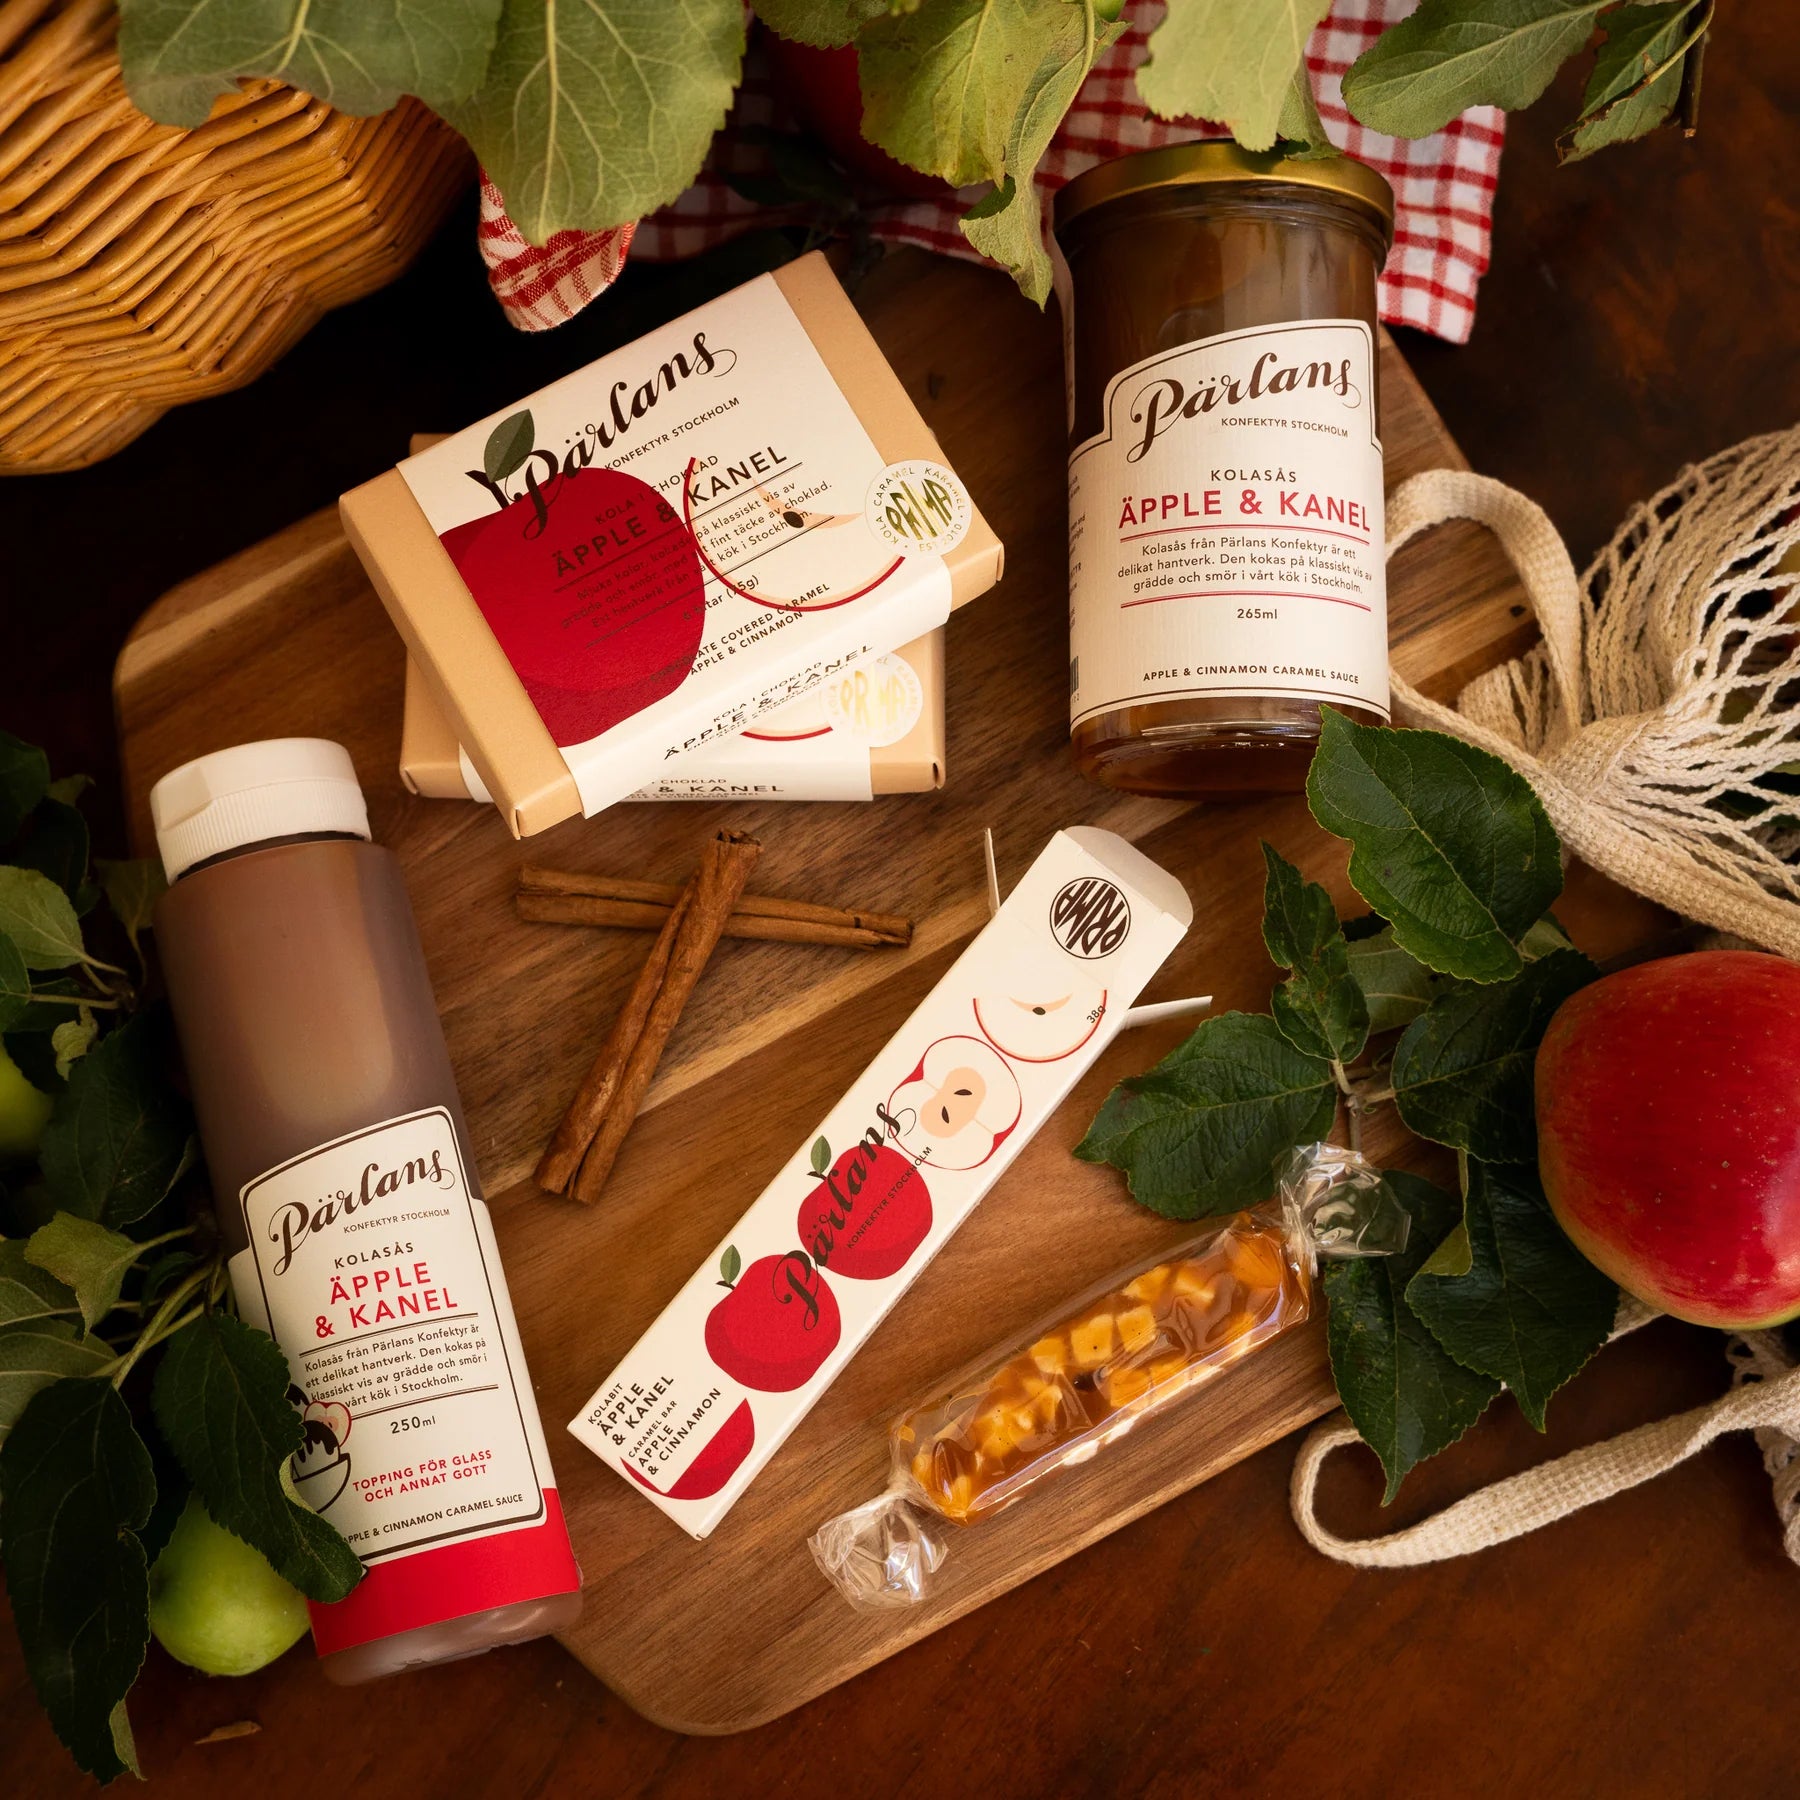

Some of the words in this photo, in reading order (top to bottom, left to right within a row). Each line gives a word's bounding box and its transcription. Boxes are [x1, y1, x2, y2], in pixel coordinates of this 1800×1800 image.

[1126, 352, 1362, 464] Pärlans
[1221, 417, 1288, 428] KONFEKTYR
[1291, 420, 1349, 438] STOCKHOLM
[505, 332, 737, 541] Pärlans
[604, 433, 670, 471] KONFEKTYR
[671, 397, 740, 438] STOCKHOLM
[595, 498, 636, 526] KOLA
[649, 455, 719, 495] CHOKLAD
[873, 467, 915, 507] CARAMEL
[1211, 467, 1297, 483] KOLASÅS
[551, 515, 647, 578] ÄPPLE
[655, 502, 676, 524] &
[686, 446, 787, 507] KANEL
[691, 545, 709, 560] et
[710, 532, 732, 549] fint
[734, 515, 765, 536] täcke
[768, 507, 781, 519] av
[784, 480, 833, 510] choklad.
[695, 526, 710, 542] på
[711, 500, 762, 530] klassiskt
[763, 488, 780, 503] vis
[783, 481, 795, 494] av
[875, 515, 900, 545] KOLA
[885, 478, 953, 541] PRIMA
[1118, 489, 1222, 529] ÄPPLE
[1239, 489, 1262, 516] &
[1280, 490, 1370, 532] KANEL
[693, 557, 716, 576] våt
[717, 547, 740, 562] kök
[748, 509, 813, 546] Stockhm.
[1118, 562, 1153, 578] delikat
[1157, 554, 1215, 570] hantverk.
[1220, 553, 1246, 564] Den
[1250, 553, 1286, 565] kokas
[1290, 555, 1305, 569] på
[1308, 556, 1351, 574] klassiskt
[1353, 566, 1363, 578] vis
[1365, 572, 1372, 581] av
[1142, 540, 1186, 556] Kolasås
[1191, 538, 1215, 550] från
[1221, 536, 1266, 548] Pärlans
[1271, 537, 1328, 554] Konfektyr
[1331, 543, 1341, 555] är
[1344, 548, 1356, 559] ett
[1133, 575, 1174, 593] grädde
[1178, 571, 1201, 583] och
[1205, 570, 1237, 582] smör
[1249, 569, 1274, 581] vårt
[1278, 570, 1300, 582] kök
[1311, 573, 1363, 594] Stockholm.
[720, 612, 773, 645] COVERED
[776, 583, 830, 615] CARAMEL
[1237, 608, 1278, 619] 265ml
[691, 653, 725, 676] APPLE
[728, 645, 737, 655] &
[739, 611, 803, 648] CINNAMON
[713, 702, 747, 723] KOLA
[761, 662, 822, 697] CHOKLAD
[840, 670, 907, 729] PRMA
[1143, 667, 1178, 682] APPLE
[1183, 666, 1191, 676] &
[1196, 665, 1267, 676] CINNAMON
[1273, 665, 1327, 679] CARAMEL
[1330, 670, 1359, 684] SAUCE
[664, 711, 744, 760] ÄPPLE
[758, 697, 773, 708] &
[787, 645, 873, 693] KANEL
[1054, 879, 1128, 956] PRIMA
[1086, 1005, 1107, 1024] 38g
[268, 1149, 455, 1276] Pärlans
[343, 1215, 399, 1234] KONFEKTYR
[401, 1208, 450, 1222] STOCKHOLM
[772, 1102, 917, 1331] Pärlans
[846, 1199, 890, 1250] KONFEKTYR
[887, 1146, 932, 1199] STOCKHOLM
[334, 1241, 414, 1269] KOLASÅS
[330, 1262, 431, 1305] ÄPPLE
[315, 1315, 335, 1339] &
[349, 1287, 458, 1329] KANEL
[305, 1353, 344, 1373] Kolasås
[346, 1347, 369, 1360] från
[372, 1337, 414, 1353] Pärlans
[417, 1325, 468, 1342] Konfektyr
[471, 1324, 480, 1334] är
[305, 1376, 320, 1389] ett
[322, 1365, 359, 1383] delikat
[362, 1352, 416, 1372] hantverk.
[420, 1347, 442, 1358] Den
[444, 1340, 473, 1353] kokas
[476, 1338, 486, 1349] på
[311, 1382, 355, 1402] klassiskt
[357, 1377, 373, 1389] vis
[376, 1374, 389, 1384] av
[393, 1363, 434, 1382] grädde
[437, 1357, 456, 1370] och
[459, 1354, 481, 1366] smör
[345, 1395, 367, 1409] vårt
[370, 1388, 391, 1402] kök
[401, 1374, 463, 1393] Stockholm.
[587, 1382, 623, 1425] KOLABIT
[390, 1415, 436, 1434] 250ml
[597, 1383, 645, 1437] ÄPPLE
[612, 1433, 627, 1446] &
[624, 1376, 674, 1429] KANEL
[628, 1420, 662, 1458] CARAMEL
[661, 1400, 678, 1418] BAR
[647, 1465, 659, 1475] &
[659, 1387, 721, 1461] CINNAMON
[352, 1467, 414, 1492] TOPPING
[419, 1458, 447, 1474] FÖR
[452, 1449, 493, 1467] GLASS
[638, 1424, 674, 1468] APPLE
[364, 1486, 393, 1503] OCH
[399, 1473, 447, 1494] ANNAT
[453, 1464, 488, 1480] GOTT
[343, 1530, 370, 1544] APPLE
[372, 1527, 380, 1537] &
[383, 1511, 443, 1533] CINNAMON
[446, 1499, 494, 1517] CARAMEL
[495, 1493, 524, 1506] SAUCE
